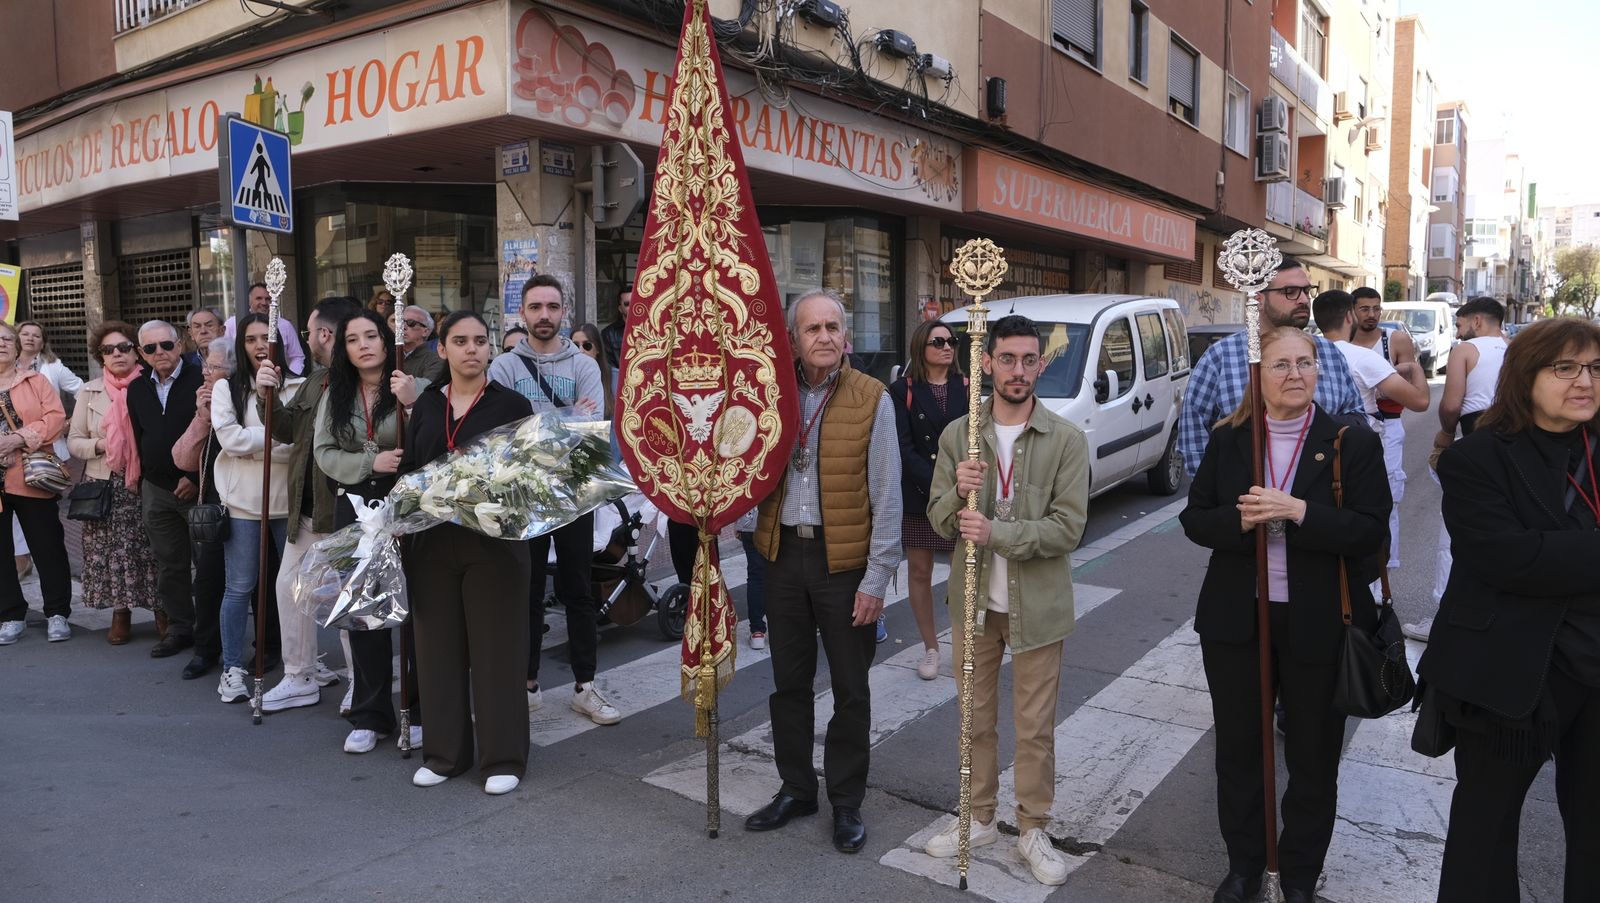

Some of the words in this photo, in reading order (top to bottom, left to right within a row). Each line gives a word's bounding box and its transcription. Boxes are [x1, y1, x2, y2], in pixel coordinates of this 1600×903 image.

[324, 35, 485, 127] HOGAR
[638, 68, 903, 182] HRAMIENTAS
[79, 129, 102, 179] DE
[109, 100, 220, 170] REGALO
[993, 164, 1132, 238] SUPERMERCA
[1142, 212, 1188, 251] CHINA
